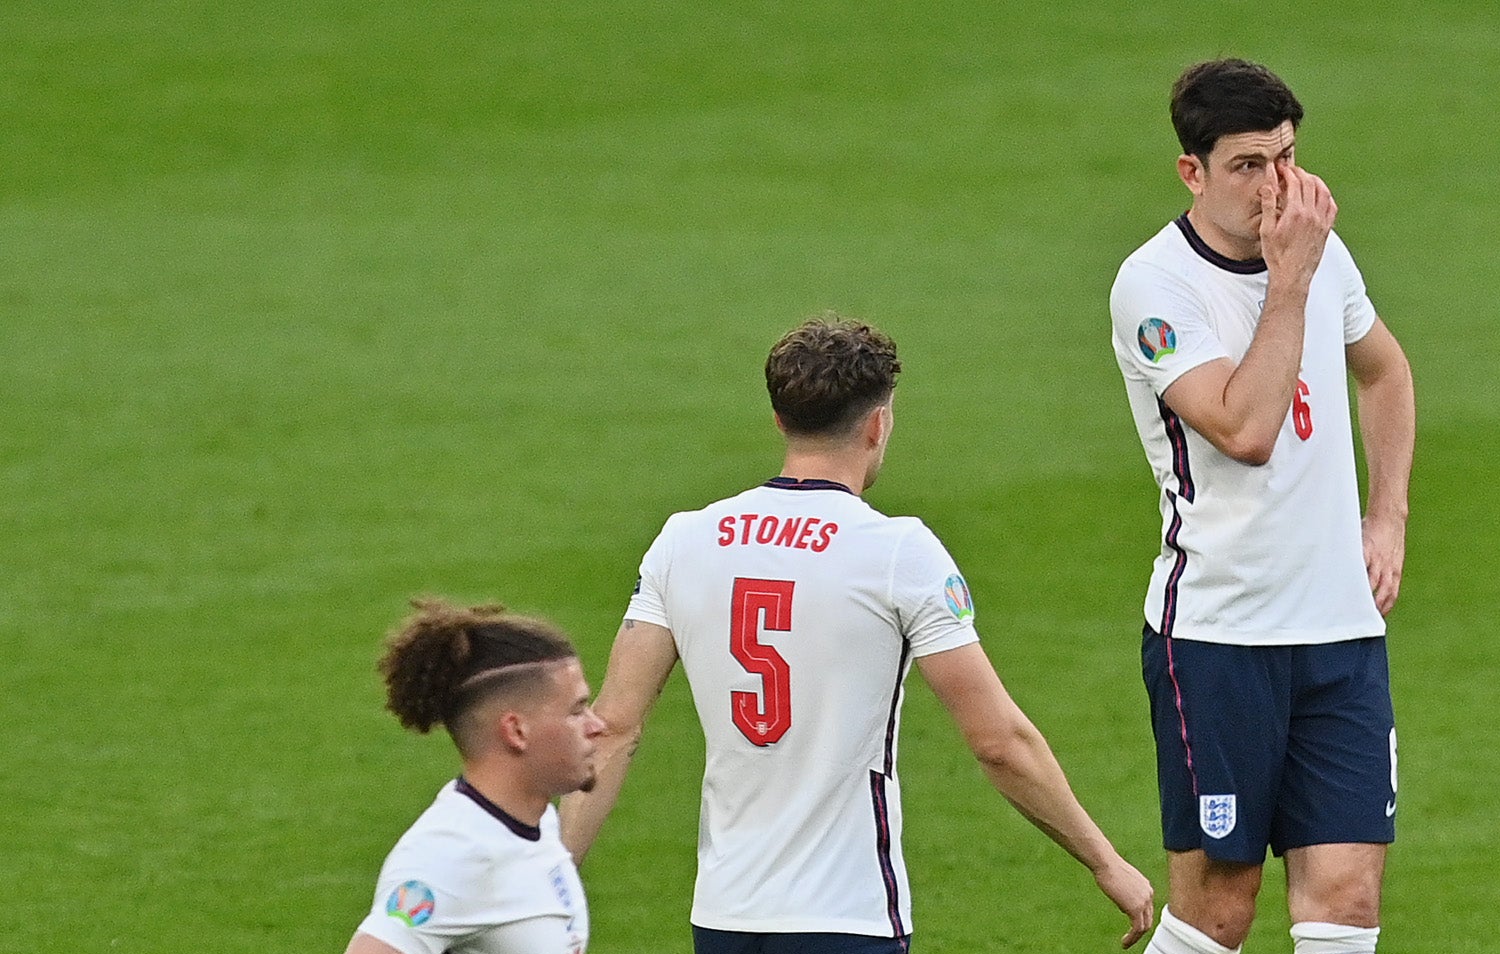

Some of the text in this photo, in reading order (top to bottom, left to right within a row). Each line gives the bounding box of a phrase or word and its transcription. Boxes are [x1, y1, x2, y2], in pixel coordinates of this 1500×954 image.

[1292, 379, 1313, 441] 6
[718, 514, 839, 553] STONES
[729, 577, 796, 747] 5
